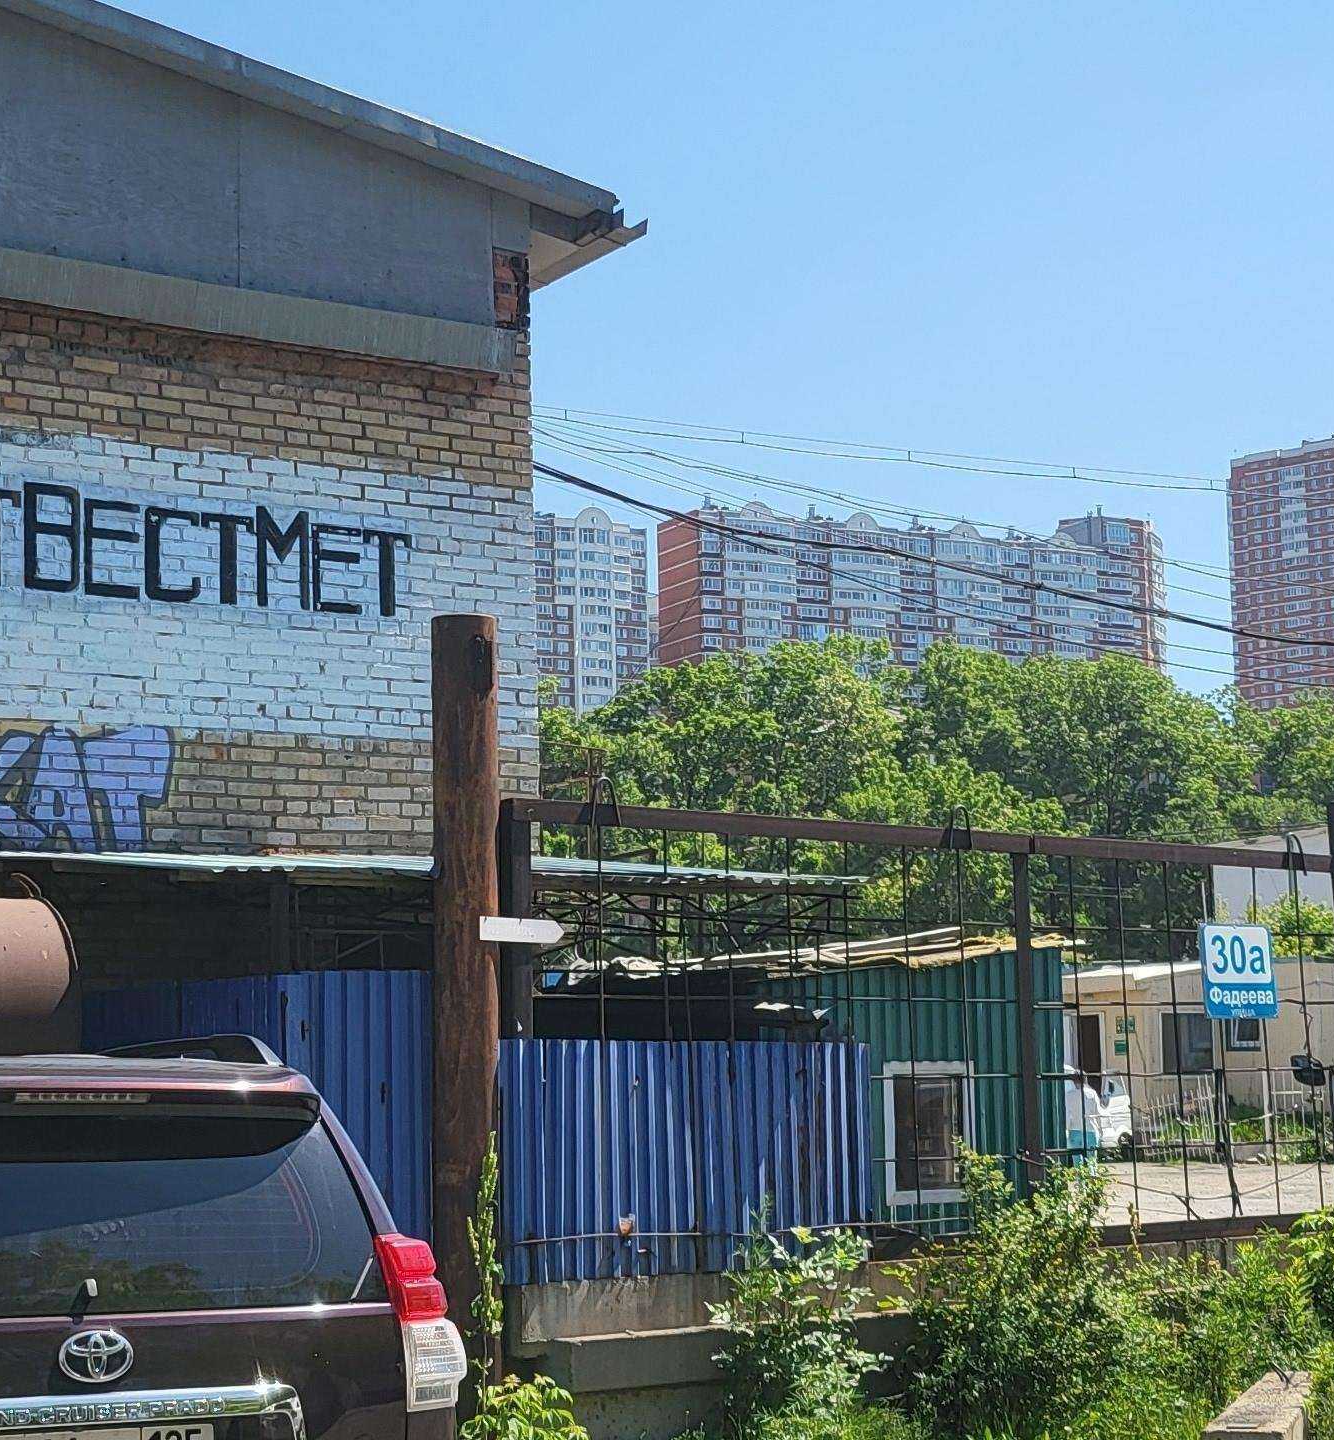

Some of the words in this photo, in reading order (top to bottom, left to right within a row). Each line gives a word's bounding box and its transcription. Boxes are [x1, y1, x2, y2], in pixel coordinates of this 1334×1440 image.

[1211, 934, 1266, 974] 30а
[1209, 986, 1275, 1007] Фадеева
[38, 1402, 147, 1423] CRUISER
[149, 1396, 227, 1416] PRADO
